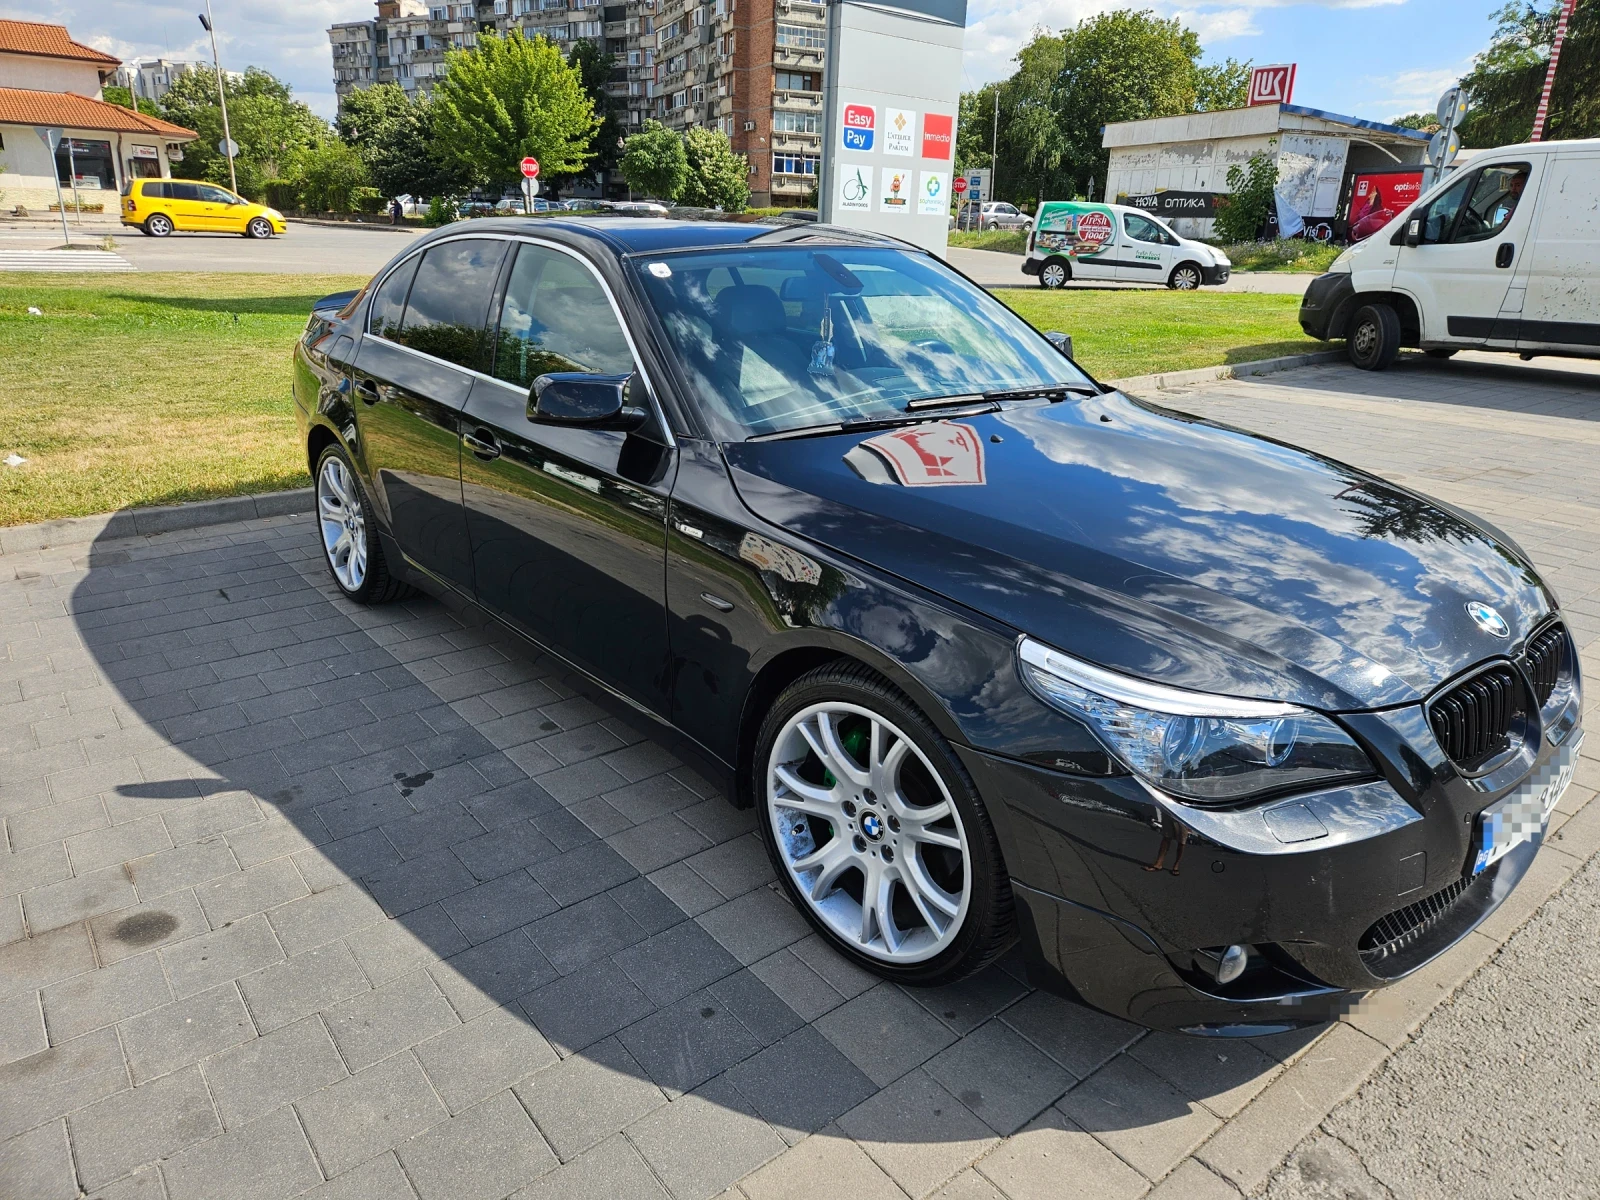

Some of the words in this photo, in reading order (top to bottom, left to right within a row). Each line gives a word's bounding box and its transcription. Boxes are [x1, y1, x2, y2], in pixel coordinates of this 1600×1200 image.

[848, 110, 872, 128] Easy
[847, 130, 866, 147] Pay
[522, 163, 538, 172] STOP
[954, 181, 967, 189] STOP
[1135, 195, 1158, 207] HOYA
[1164, 198, 1206, 208] ОПТИКА
[1083, 214, 1107, 226] fresh
[1083, 230, 1105, 241] food
